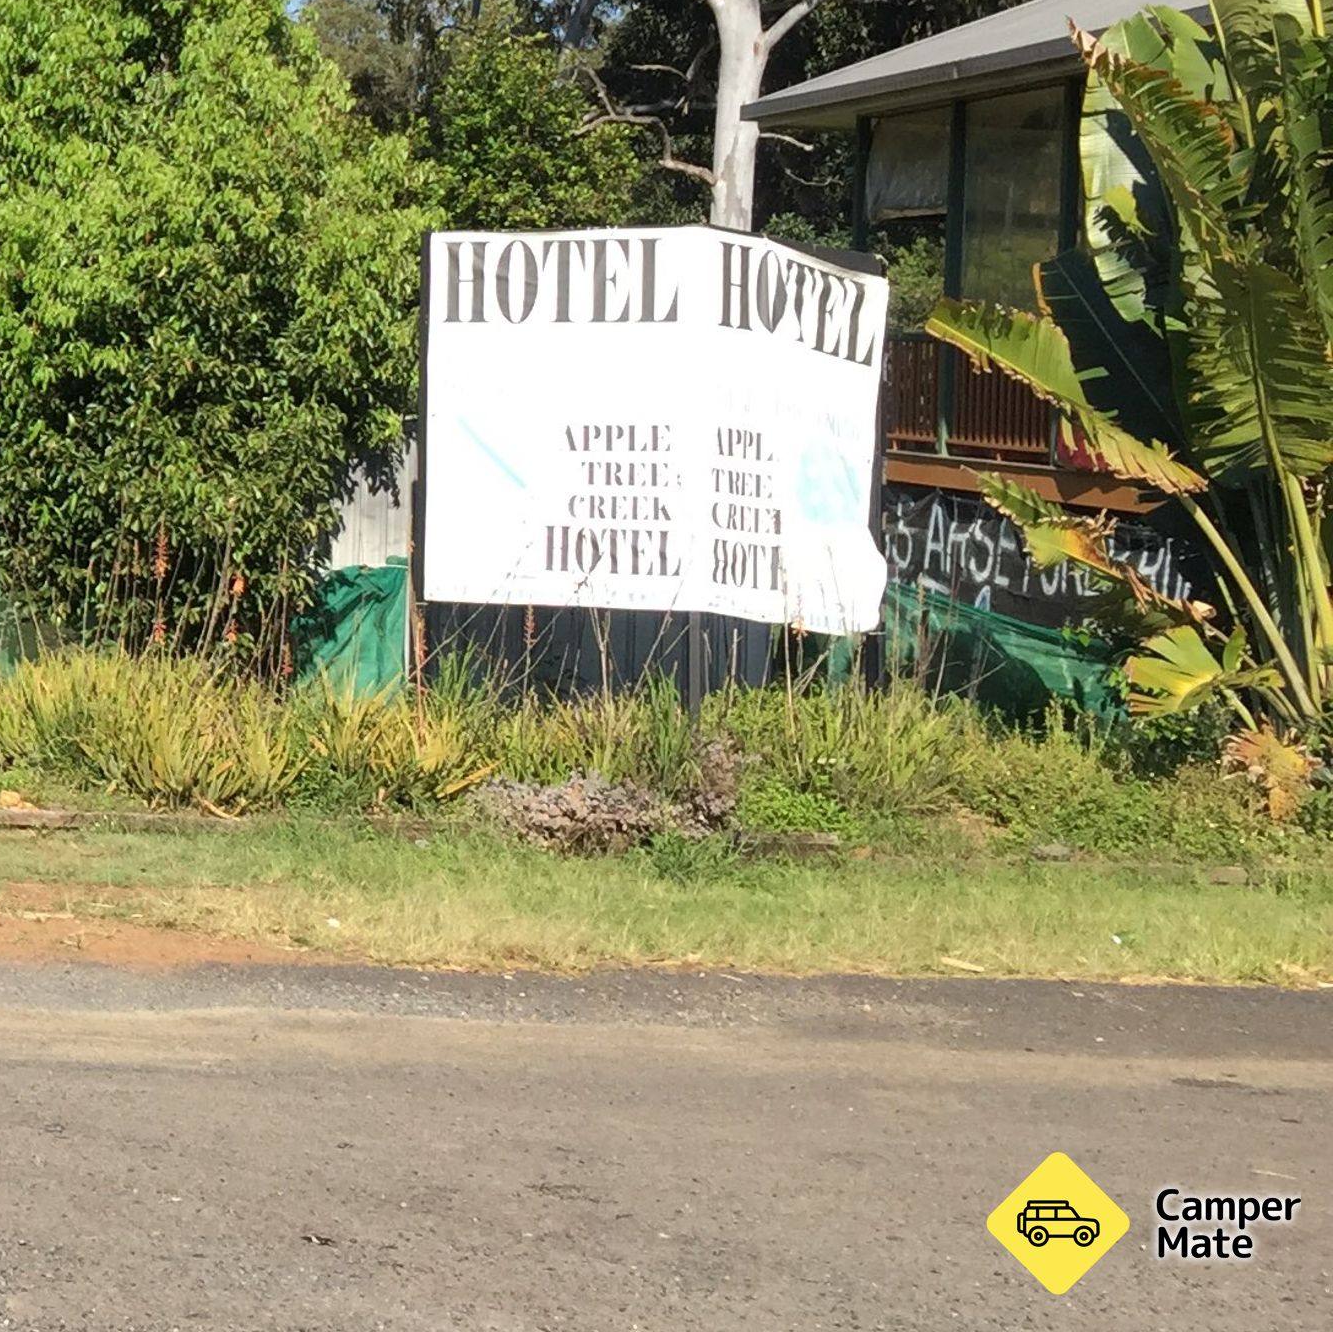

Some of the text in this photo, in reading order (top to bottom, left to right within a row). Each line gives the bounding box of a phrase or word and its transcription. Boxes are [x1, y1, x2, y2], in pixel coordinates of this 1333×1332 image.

[443, 237, 680, 325] HOTEL
[718, 240, 876, 367] HOTEL
[563, 424, 671, 453] APPLE
[716, 425, 779, 463] APPL
[581, 461, 671, 488] TREE
[710, 467, 774, 500] TREE
[567, 495, 673, 522] CREEK
[544, 524, 681, 577] HOTEL
